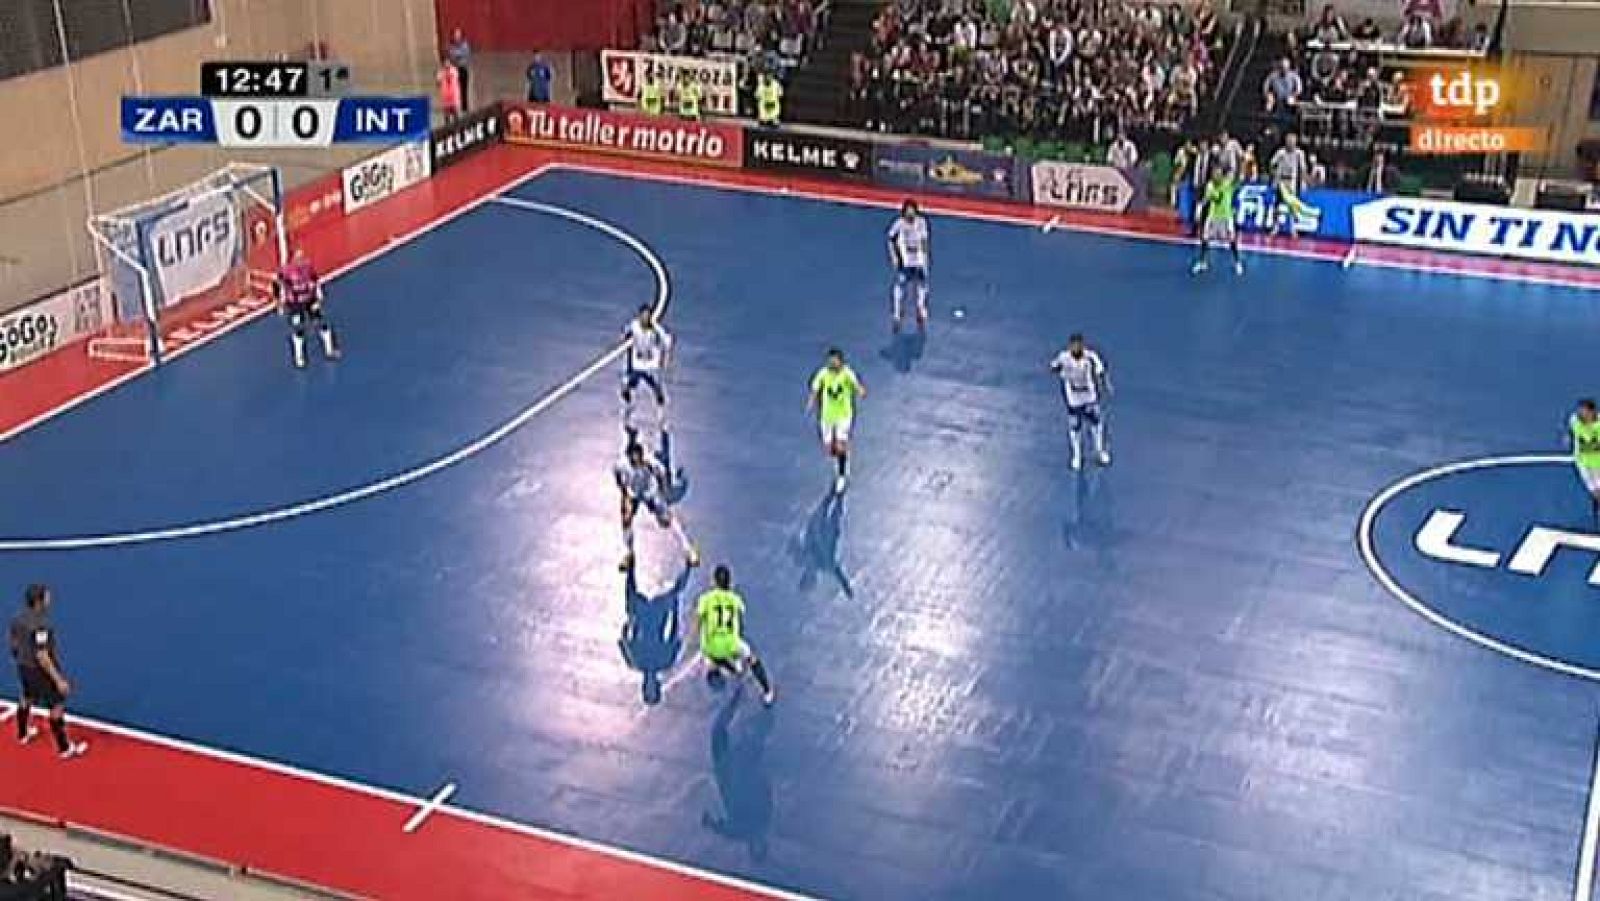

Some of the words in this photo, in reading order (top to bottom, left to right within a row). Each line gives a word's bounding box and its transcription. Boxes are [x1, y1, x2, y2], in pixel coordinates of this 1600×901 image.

[527, 109, 555, 135] Tu
[559, 111, 630, 147] taller
[633, 126, 725, 158] motrio
[753, 139, 838, 168] KELME
[1380, 206, 1477, 241] SIN
[1489, 216, 1544, 248] TI
[1548, 222, 1600, 253] N
